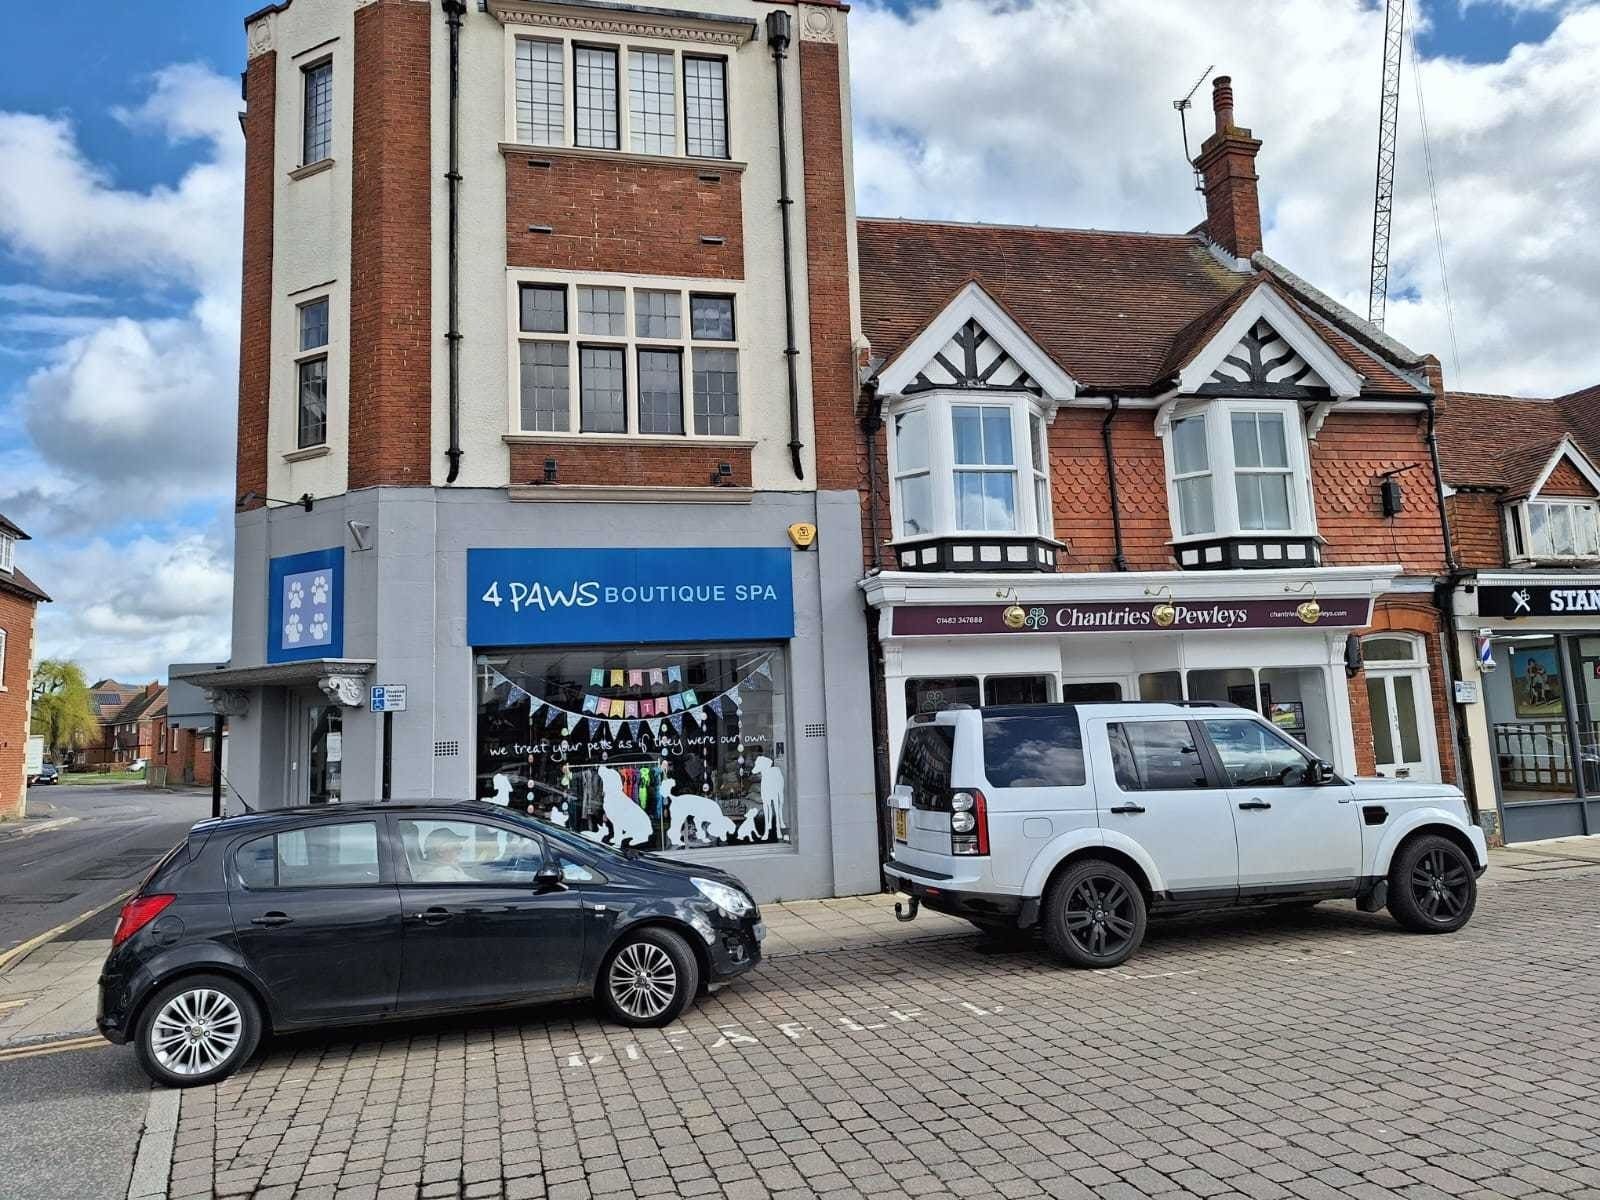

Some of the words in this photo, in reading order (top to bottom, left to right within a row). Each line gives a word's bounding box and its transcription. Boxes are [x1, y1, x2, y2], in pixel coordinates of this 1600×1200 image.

[482, 581, 503, 608] 4
[509, 581, 600, 613] PAWS
[604, 585, 726, 603] BOUTIQUE
[734, 585, 778, 602] SPA
[1550, 589, 1600, 611] STAN
[1055, 607, 1150, 627] Chantries
[1173, 606, 1248, 628] Pewleys
[489, 746, 509, 756] we
[513, 740, 549, 755] treat
[551, 740, 582, 762] your
[587, 739, 613, 759] pets
[618, 739, 633, 749] as
[638, 733, 650, 753] if
[654, 734, 684, 755] they
[687, 736, 716, 745] were
[720, 734, 740, 744] our
[744, 733, 768, 744] own
